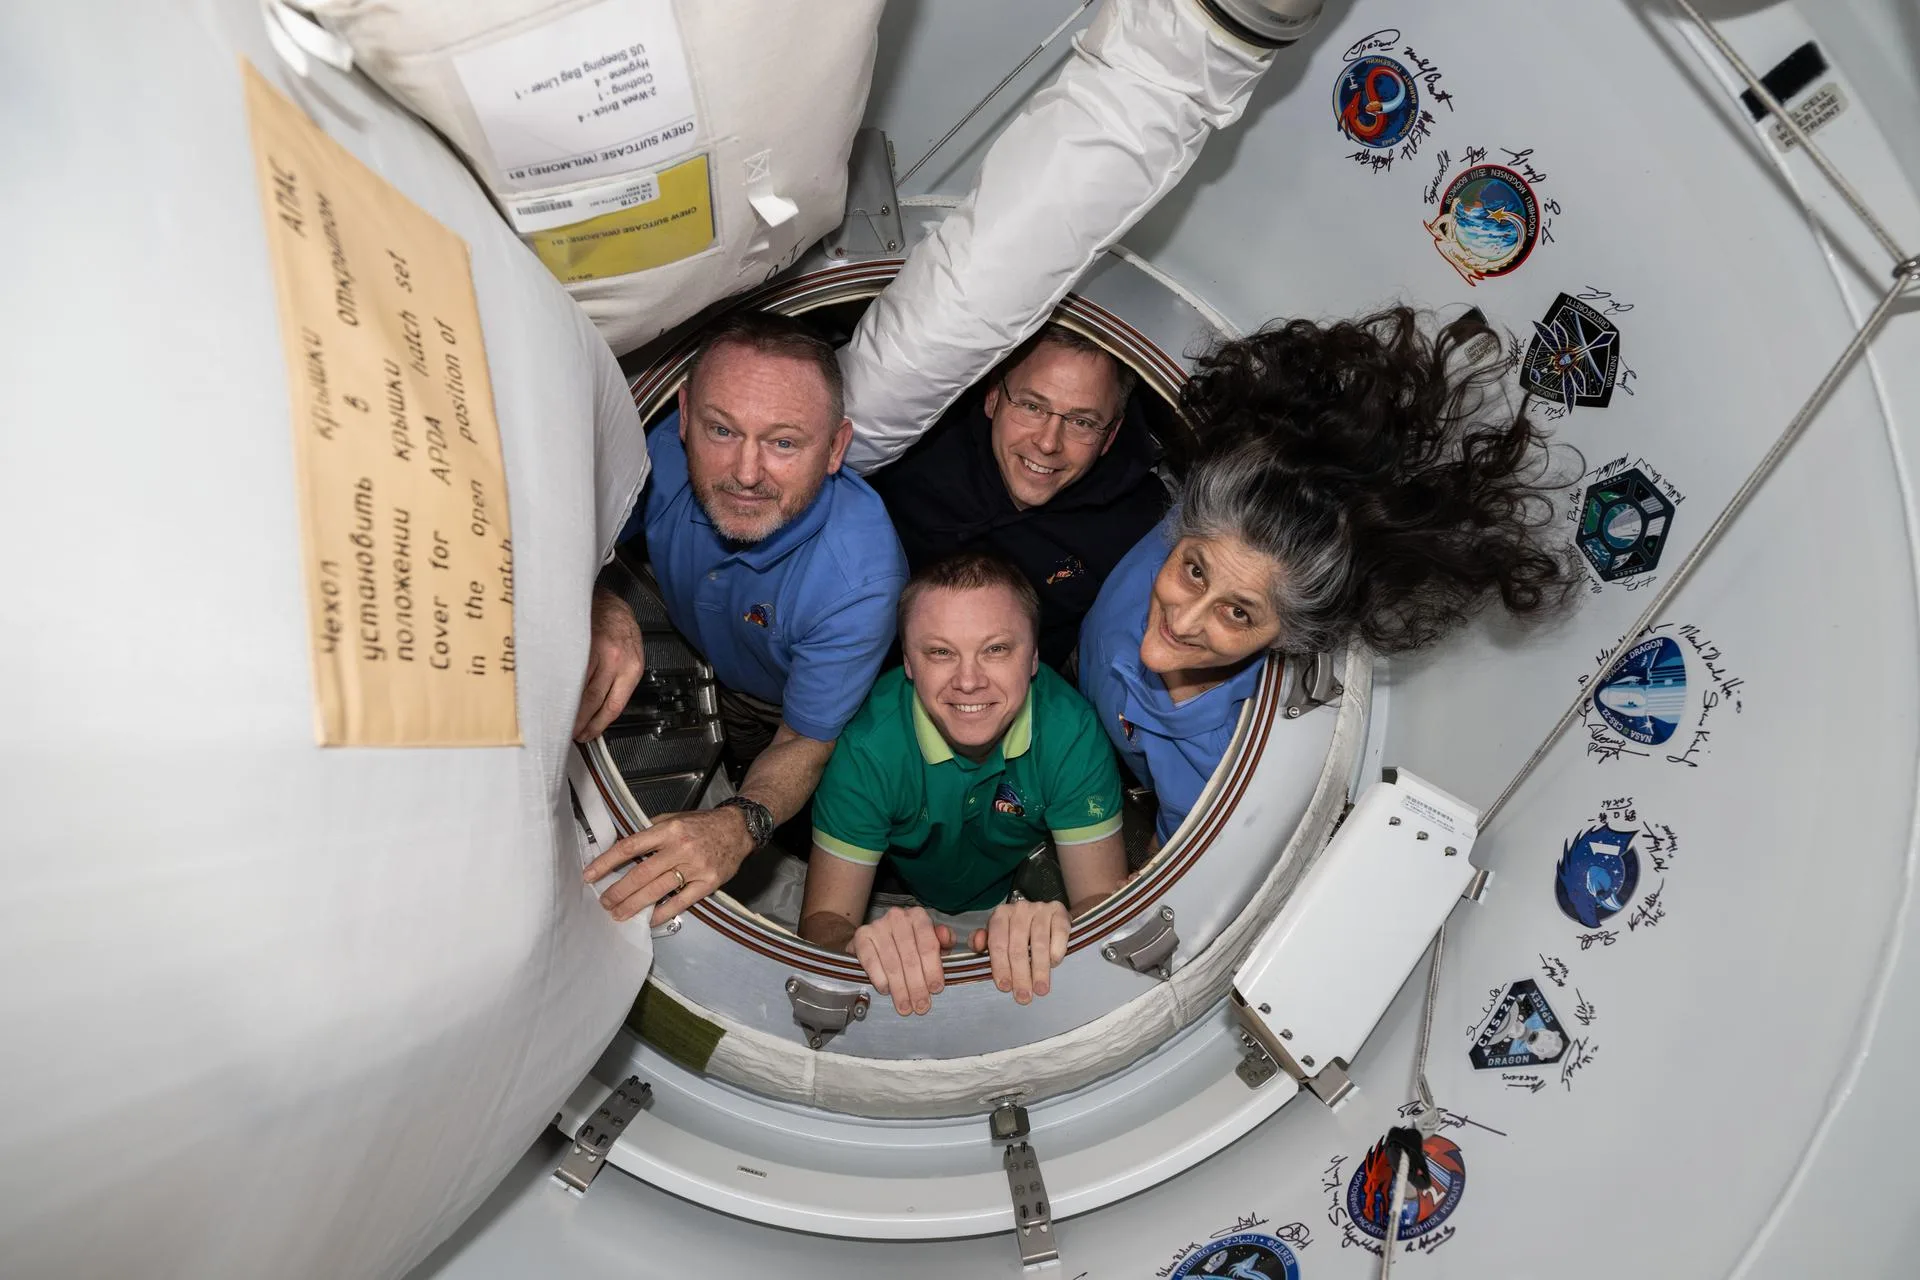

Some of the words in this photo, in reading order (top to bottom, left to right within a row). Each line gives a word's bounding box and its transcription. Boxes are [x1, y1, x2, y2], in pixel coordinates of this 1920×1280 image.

[583, 50, 629, 73] Sleeping
[630, 43, 646, 57] US
[561, 68, 582, 82] Bag
[608, 58, 649, 81] Hygiene
[514, 90, 521, 100] 1
[531, 75, 560, 93] Liner
[611, 73, 653, 96] Clothing
[622, 86, 657, 108] 2-Week
[592, 101, 620, 118] Brick
[662, 121, 694, 142] CREW
[602, 135, 659, 162] SUITCASE
[509, 170, 526, 180] B1
[528, 153, 599, 177] (WILMORE)
[1490, 169, 1526, 195] MOGENSEN
[622, 217, 670, 234] SUITCASE
[669, 206, 697, 223] CREW
[1525, 196, 1537, 238] MOGHBELI
[386, 248, 413, 294] set
[1565, 297, 1610, 329] CRISTOFORETTI
[433, 316, 457, 346] of
[398, 309, 430, 378] hatch
[1525, 348, 1536, 369] HINES
[1606, 355, 1617, 388] WATKINS
[383, 357, 418, 462] крышки
[444, 352, 479, 445] position
[424, 415, 452, 487] APDA
[470, 479, 491, 537] open
[428, 531, 449, 570] for
[392, 507, 416, 662] положении
[464, 580, 485, 620] the
[430, 595, 450, 670] Cover
[466, 654, 486, 676] in
[1604, 657, 1629, 682] SPACEX
[1629, 638, 1664, 659] DRAGON
[1602, 709, 1624, 731] CRS-22
[1630, 729, 1652, 743] NASA
[1530, 989, 1554, 1023] SPACEX
[1488, 1054, 1530, 1067] DRAGON
[1423, 1186, 1446, 1205] 2
[1401, 1216, 1440, 1237] HOSHIDE
[1176, 1249, 1209, 1276] HOBURG
[1267, 1240, 1295, 1266] ФЕДЯЕВ
